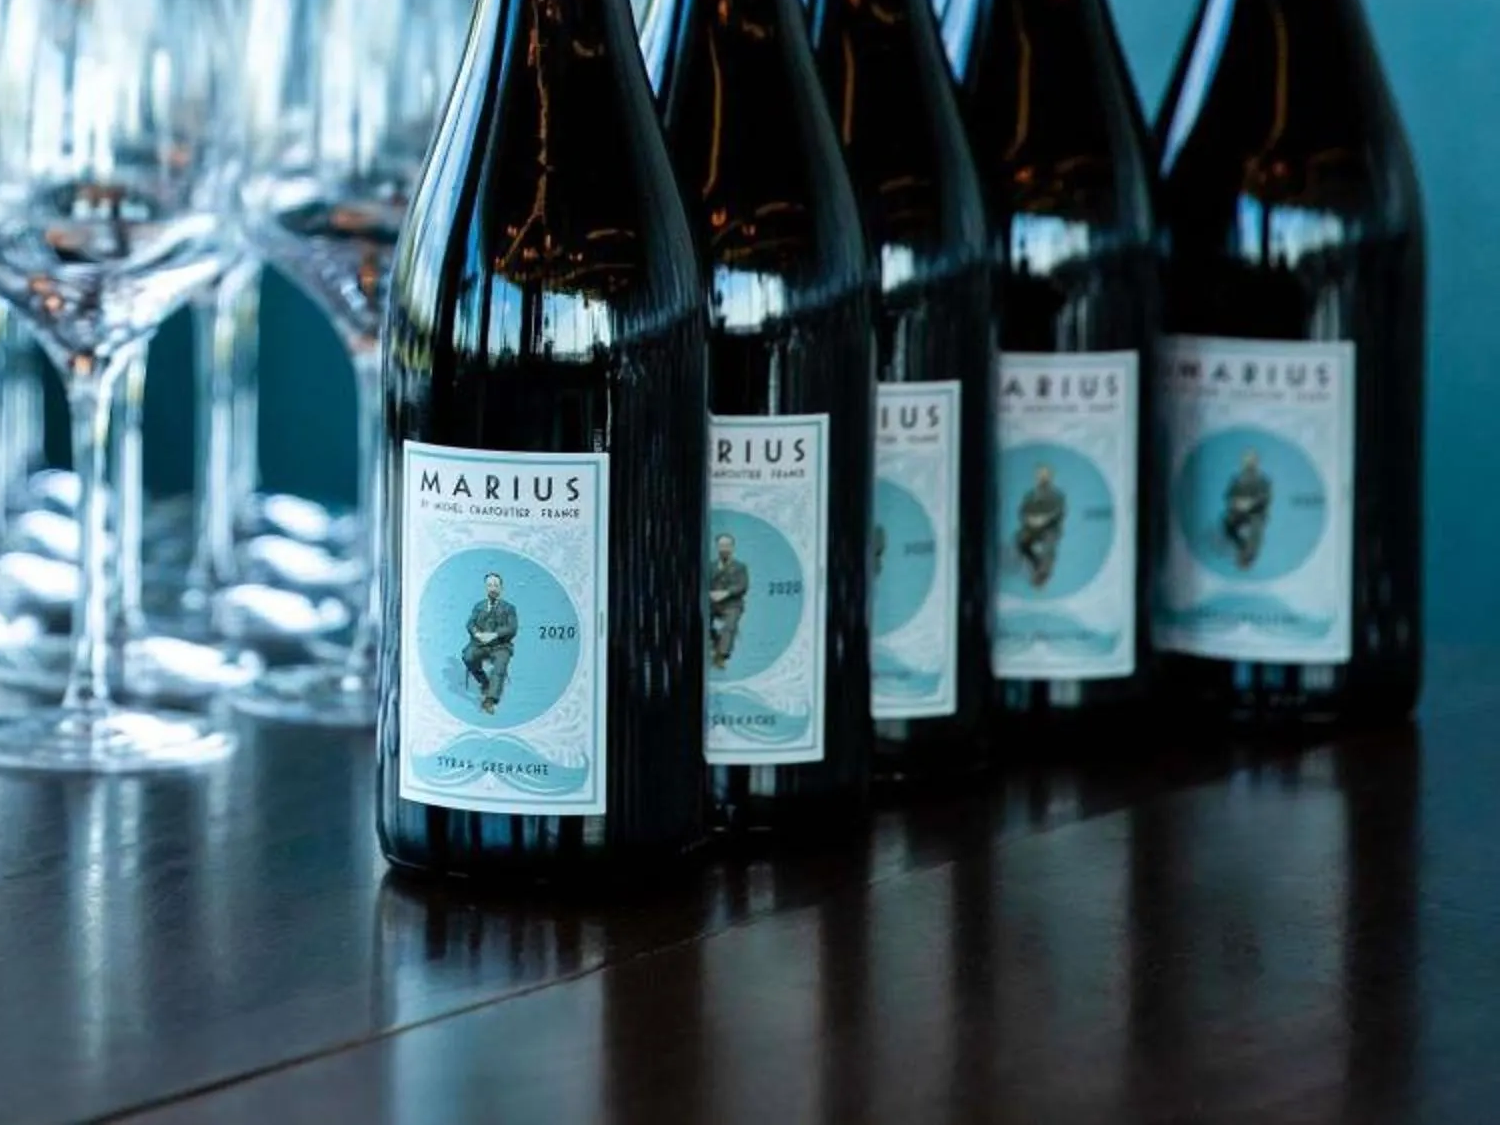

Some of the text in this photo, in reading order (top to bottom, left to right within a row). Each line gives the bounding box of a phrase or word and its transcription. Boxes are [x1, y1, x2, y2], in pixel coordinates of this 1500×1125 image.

[717, 438, 806, 464] RIUS
[420, 468, 580, 502] MARIUS
[541, 508, 580, 519] FRANCE
[539, 625, 576, 640] 2020
